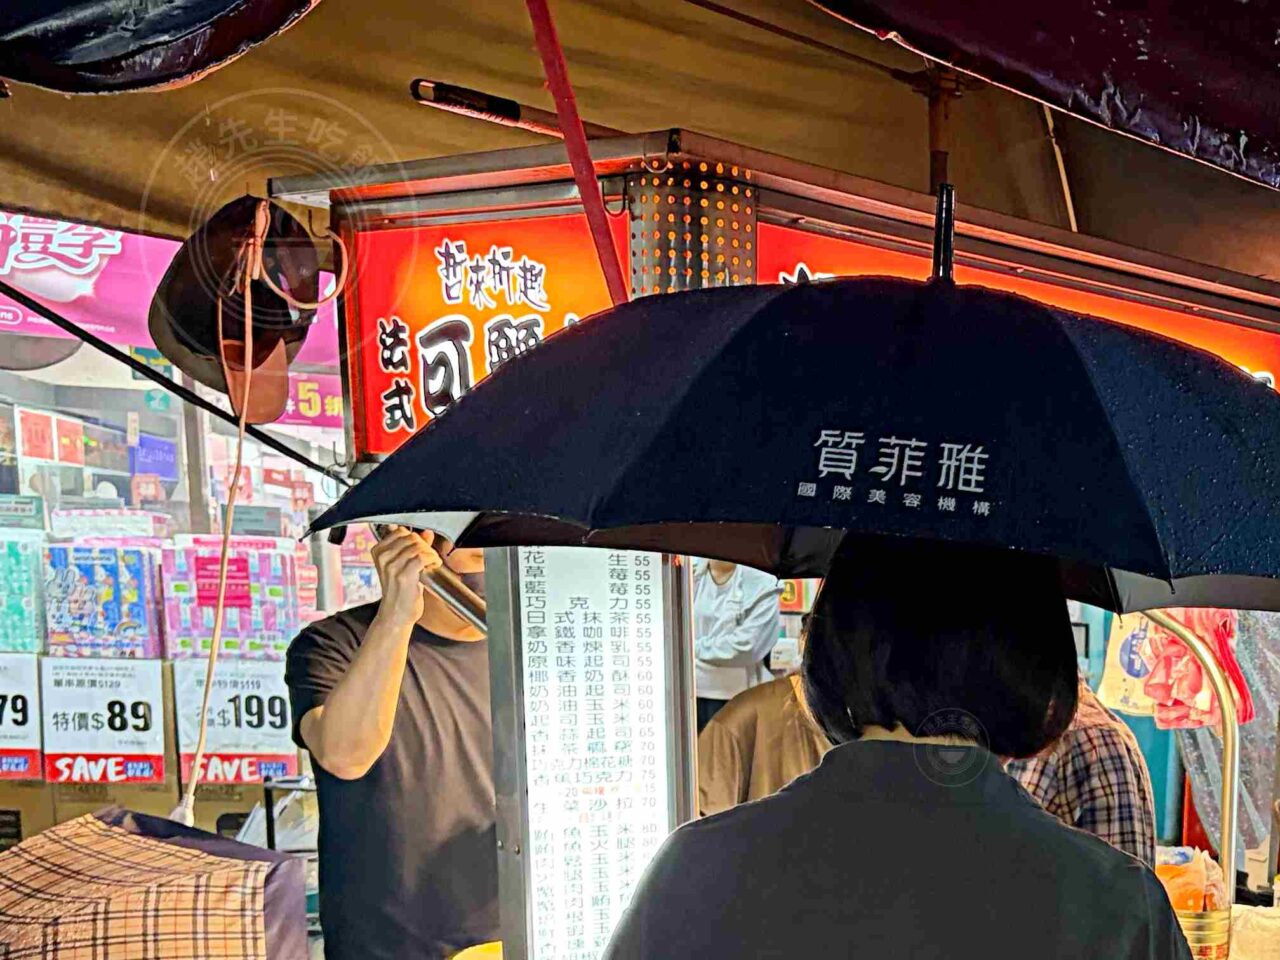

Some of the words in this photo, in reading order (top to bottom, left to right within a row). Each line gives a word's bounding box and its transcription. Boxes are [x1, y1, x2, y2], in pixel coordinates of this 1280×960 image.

[379, 319, 416, 432] 法式
[813, 430, 990, 494] 質菲雅
[797, 482, 991, 517] 國際美容機構
[523, 551, 629, 567] 花生
[634, 555, 651, 566] 55
[524, 565, 630, 580] 草莓
[634, 569, 651, 581] 55
[525, 580, 630, 596] 藍莓
[635, 584, 651, 596] 55
[525, 596, 629, 610] 巧克力
[635, 598, 651, 610] 55
[527, 611, 630, 625] 日式抹茶
[635, 613, 652, 624] 55
[527, 625, 630, 640] 拿鐵咖啡
[636, 628, 652, 639] 55
[636, 642, 653, 653] 55
[527, 655, 631, 669] 原味起司
[636, 657, 653, 667] 55
[637, 671, 653, 681] 60
[529, 684, 632, 698] 奶油起司
[637, 685, 654, 696] 60
[529, 698, 632, 713] 奶油玉米
[638, 700, 654, 710] 60
[530, 713, 632, 727] 起司玉米
[638, 714, 655, 724] 60
[55, 757, 127, 782] SAVE
[192, 756, 261, 782] SAVE
